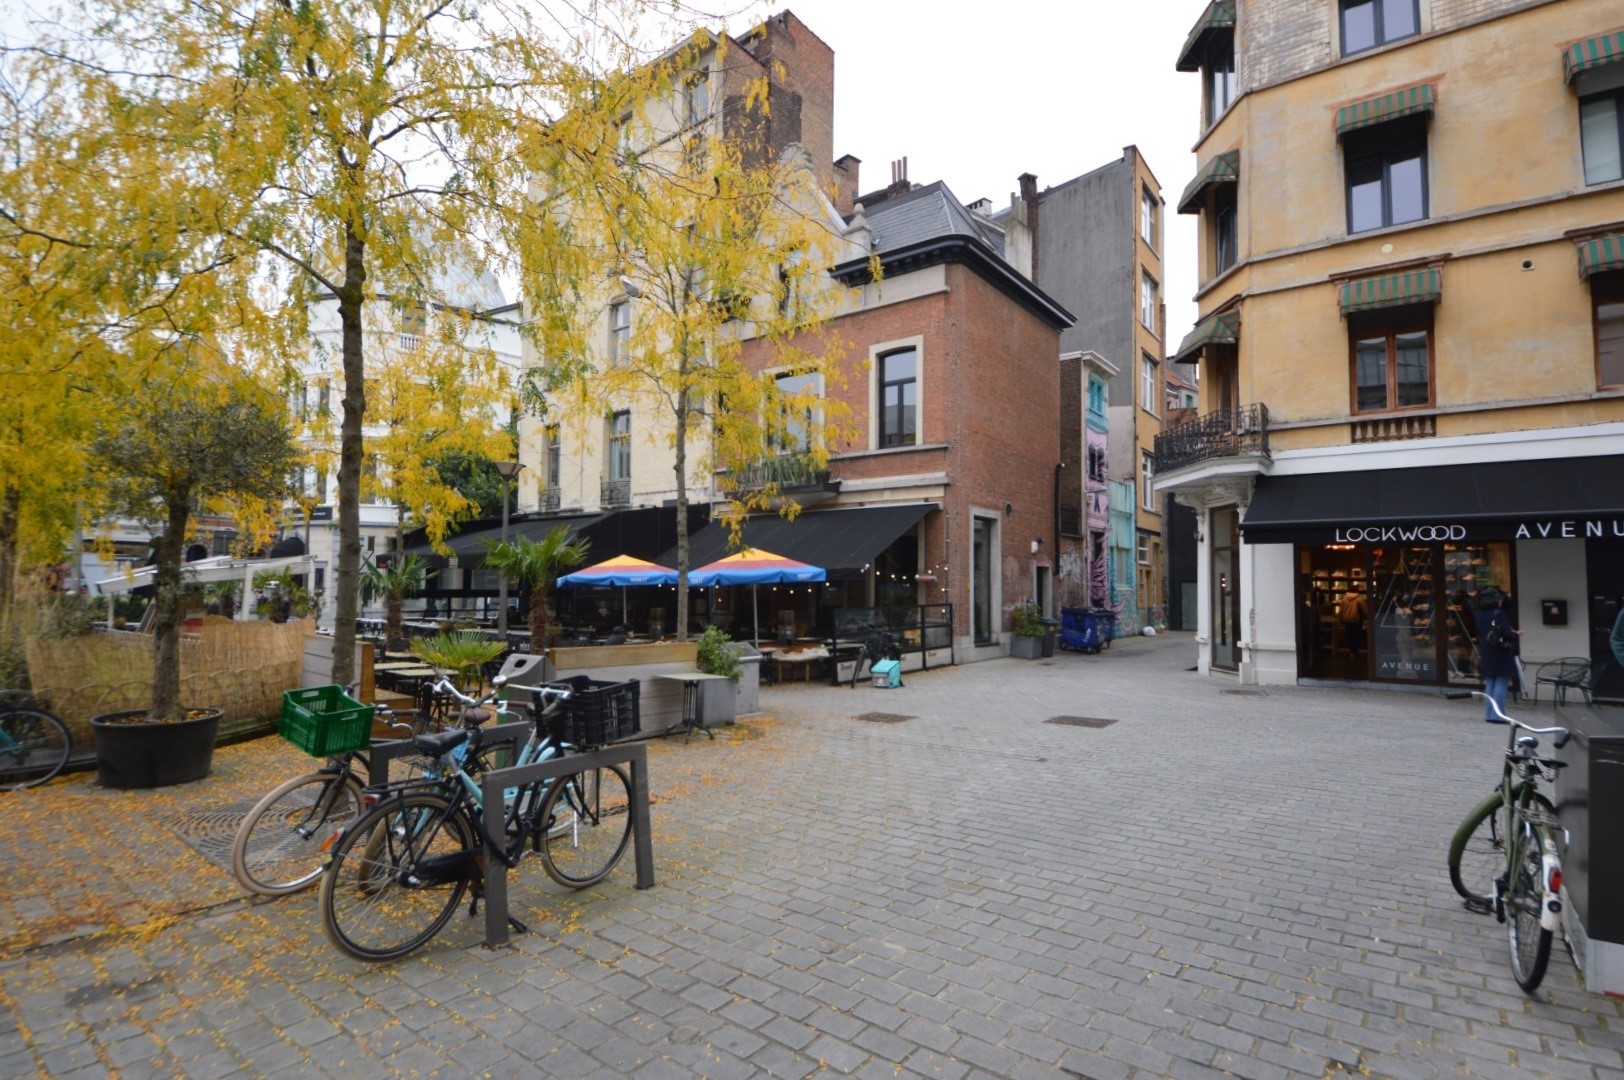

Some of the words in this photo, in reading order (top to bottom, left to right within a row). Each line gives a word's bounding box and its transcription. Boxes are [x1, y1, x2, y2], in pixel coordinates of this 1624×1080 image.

[1336, 525, 1466, 542] LOCKWOOD
[1515, 520, 1624, 539] AVENU
[1382, 661, 1429, 671] AVENUE
